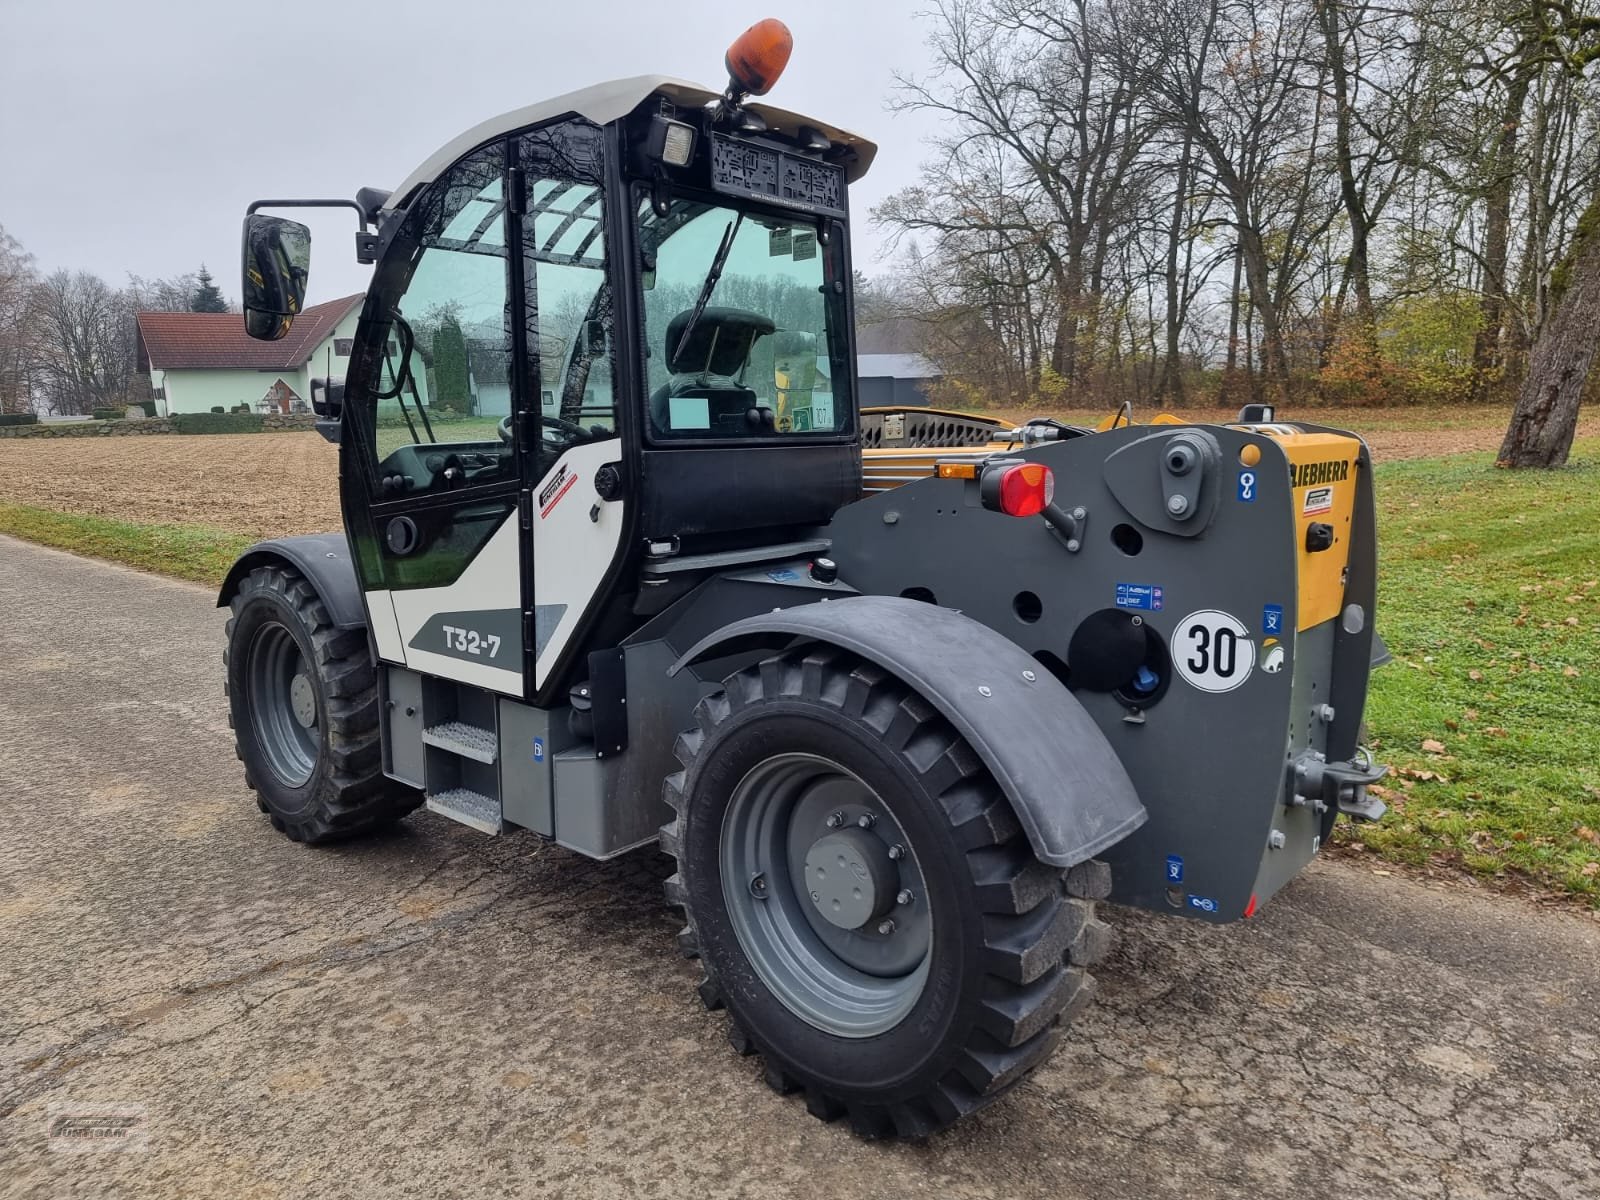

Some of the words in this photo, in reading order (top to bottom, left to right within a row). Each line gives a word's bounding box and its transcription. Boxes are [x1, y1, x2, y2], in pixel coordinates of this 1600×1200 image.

[1290, 460, 1348, 488] LIEBHERR
[442, 625, 501, 658] T32-7
[1187, 624, 1236, 678] 30
